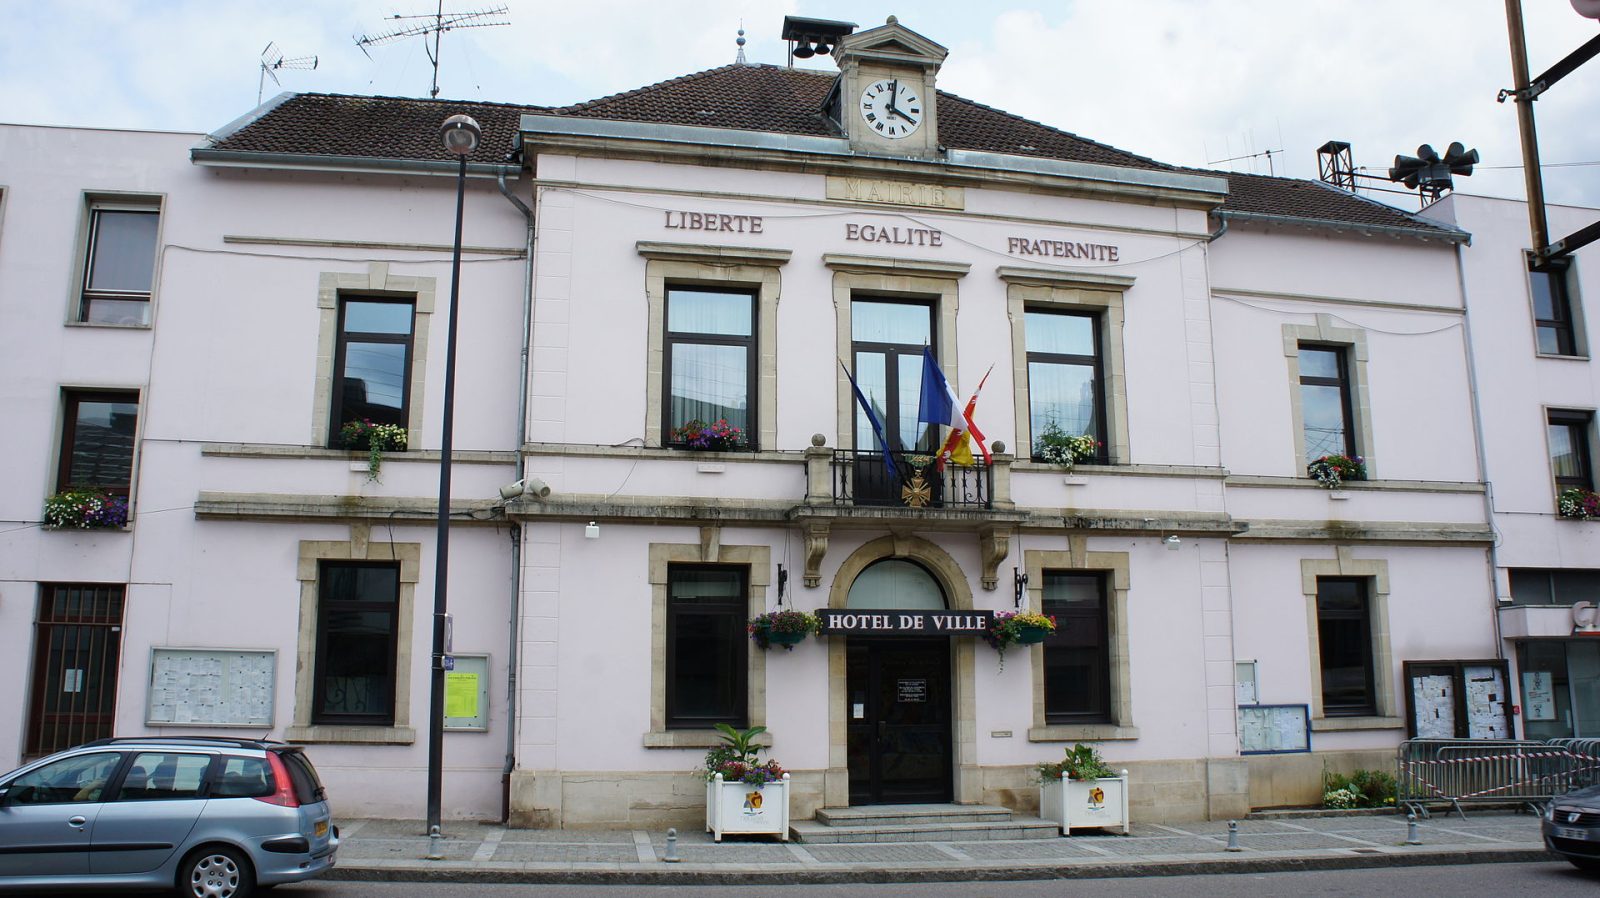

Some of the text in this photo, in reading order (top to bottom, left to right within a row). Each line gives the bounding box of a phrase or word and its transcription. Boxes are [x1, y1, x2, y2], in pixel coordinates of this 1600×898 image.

[875, 83, 884, 93] XI
[889, 126, 895, 135] VI
[901, 125, 908, 133] V
[845, 177, 945, 207] MAIRIE
[665, 210, 763, 233] LIBERTE
[845, 223, 943, 246] EGALITE
[1008, 237, 1119, 261] FRATERNITE
[828, 614, 986, 630] HOTEL DE VILLE
